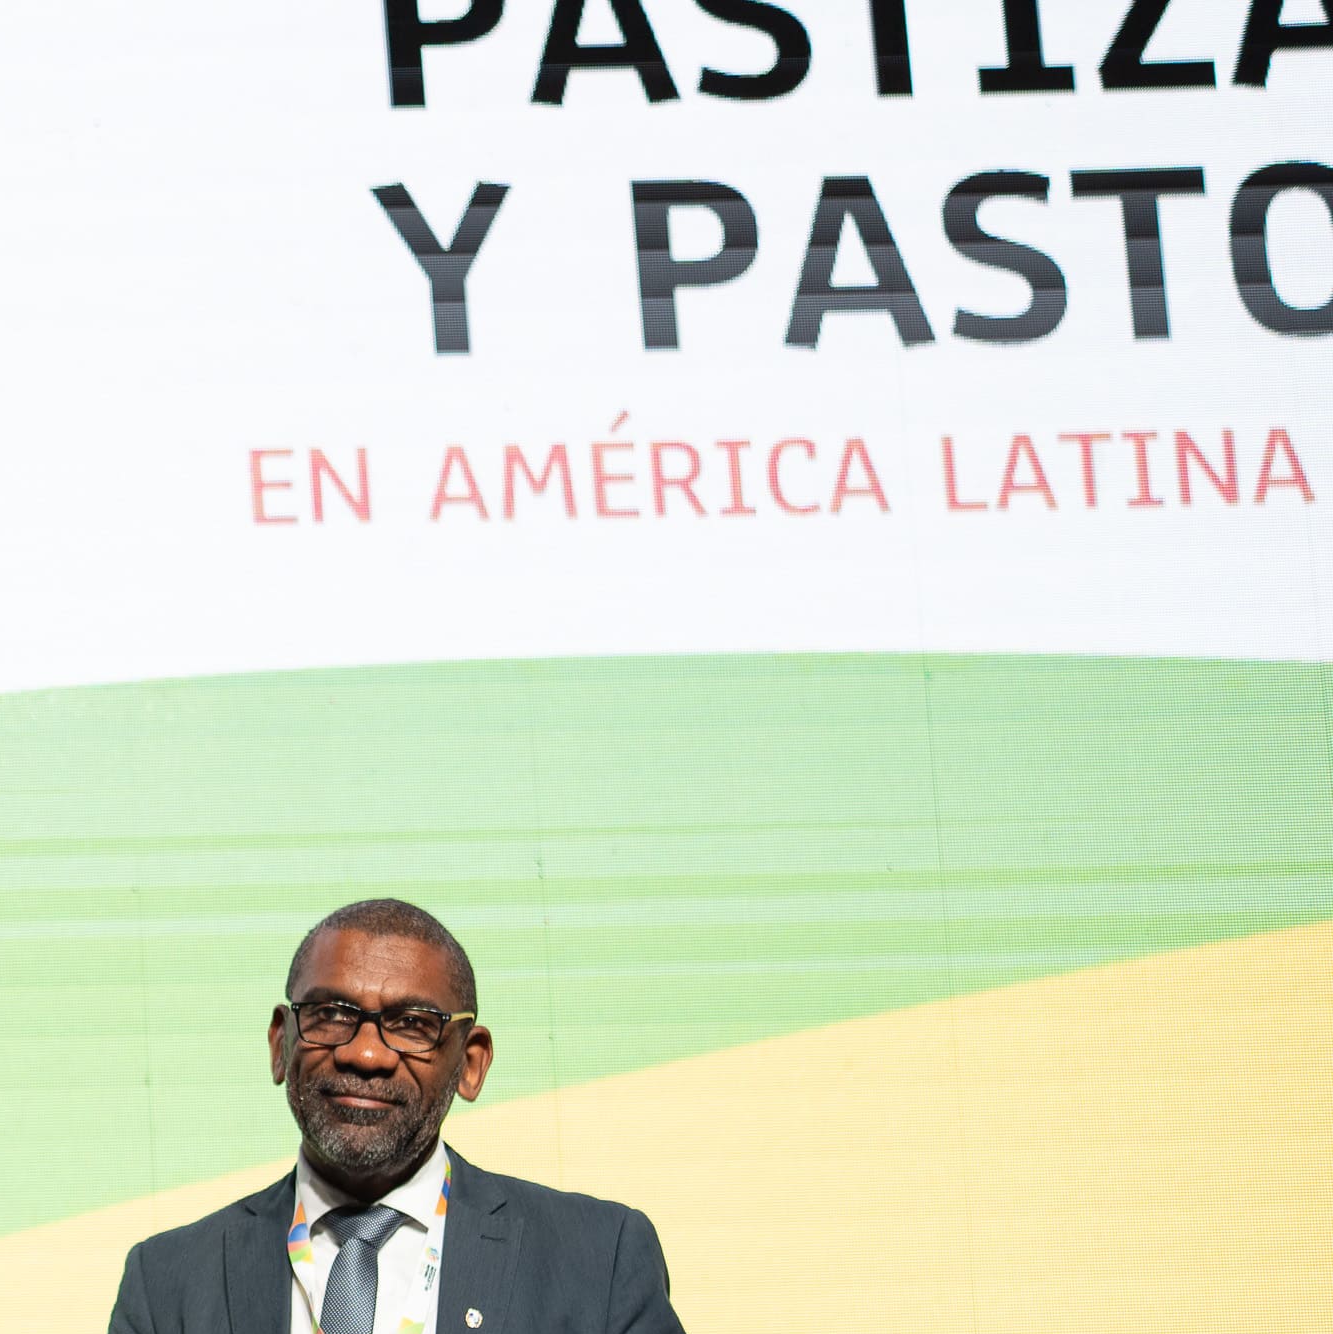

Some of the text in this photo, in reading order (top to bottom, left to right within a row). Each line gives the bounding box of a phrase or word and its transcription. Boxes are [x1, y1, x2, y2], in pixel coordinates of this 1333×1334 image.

[370, 159, 1333, 354] Y PASTO
[248, 411, 1315, 524] EN AMÉRICA LATINA
